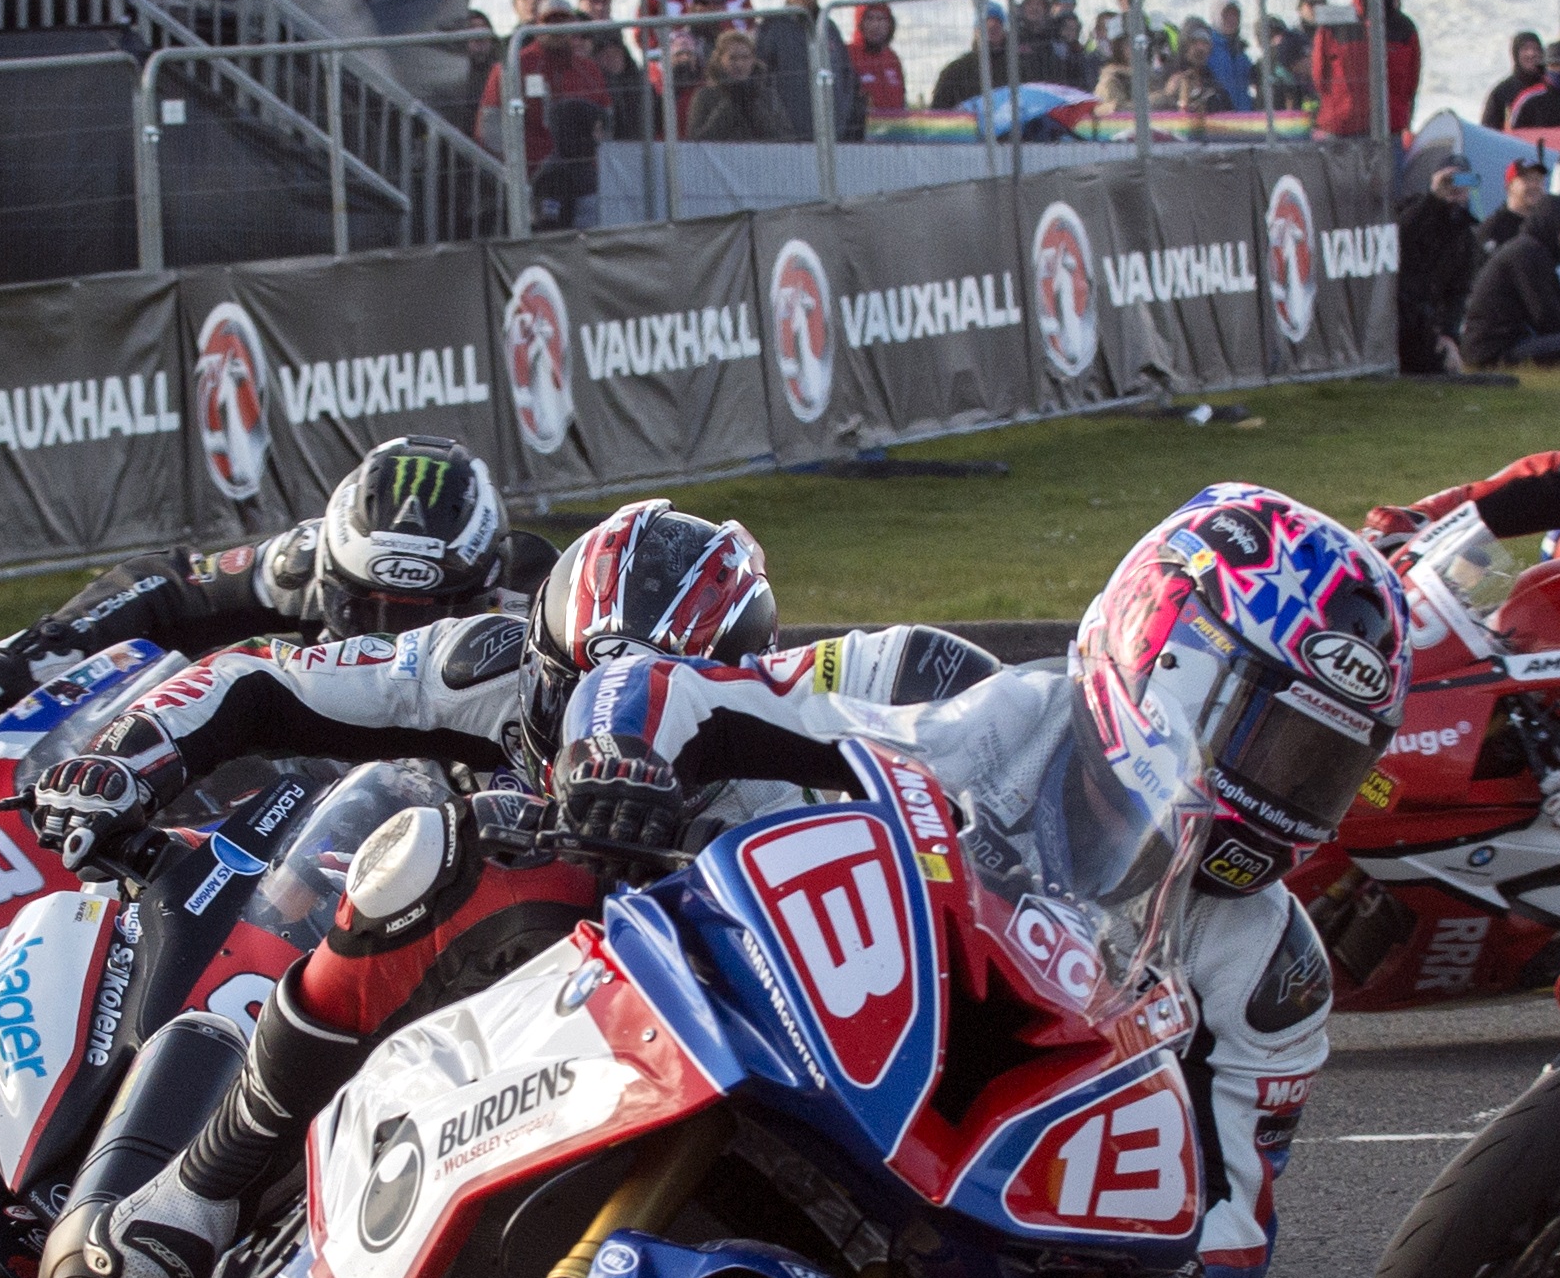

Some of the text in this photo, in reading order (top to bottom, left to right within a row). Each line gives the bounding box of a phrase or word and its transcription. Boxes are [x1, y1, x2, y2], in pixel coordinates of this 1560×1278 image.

[1102, 241, 1257, 307] VAUXHALL
[839, 271, 1022, 349] VAUXHALL
[581, 303, 762, 380] VAUXHALL
[280, 345, 488, 424] VAUXHALL
[383, 560, 431, 583] Arai
[1193, 616, 1236, 653] PIRTEK
[1318, 635, 1386, 693] Arai
[891, 768, 950, 843] MOTUL
[1258, 802, 1300, 837] Valley
[1209, 859, 1262, 890] CAB
[1227, 843, 1266, 874] fona
[187, 866, 235, 914] KS Advisory
[750, 818, 907, 1019] 13
[126, 901, 141, 945] FUCHS
[739, 928, 827, 1090] BMW Motorrad
[436, 1057, 578, 1160] BURDENS
[443, 1134, 502, 1176] WOLSELEY
[1056, 1088, 1186, 1221] 13
[602, 1252, 632, 1271] HEL
